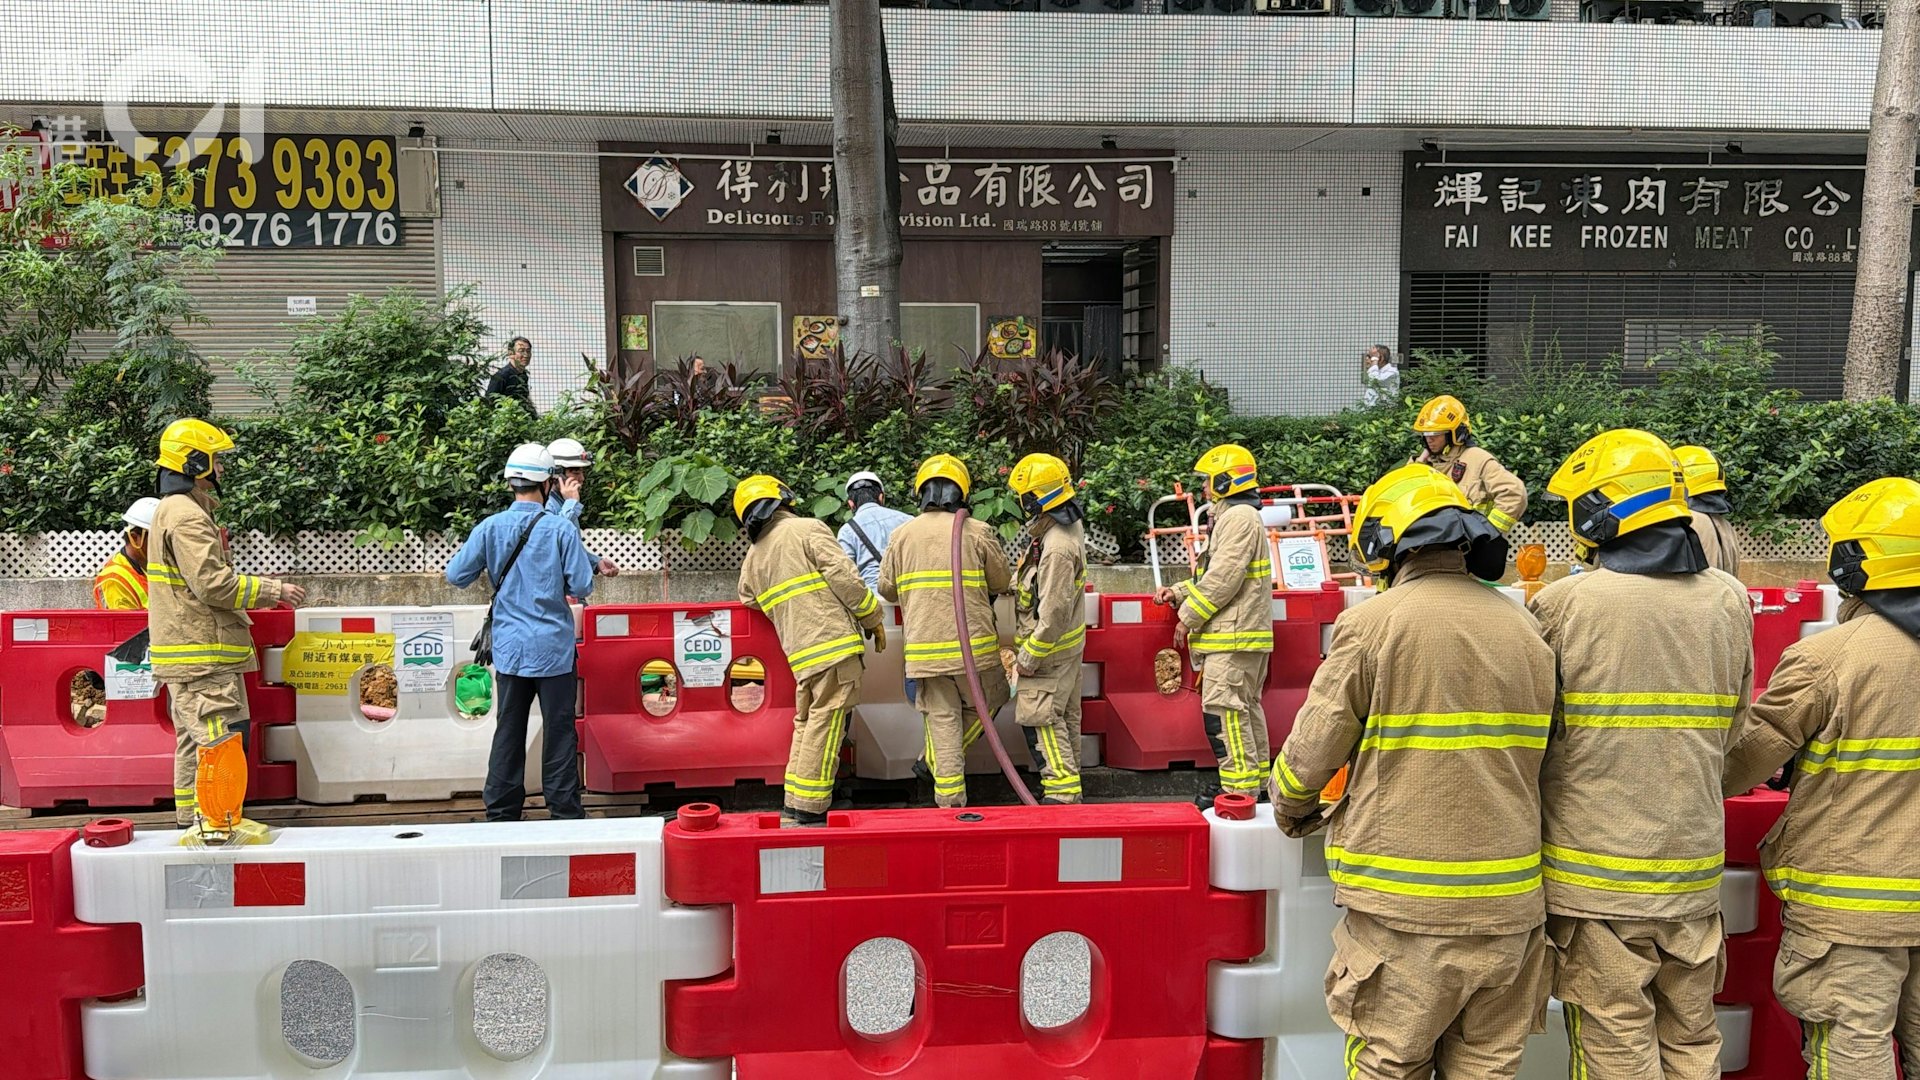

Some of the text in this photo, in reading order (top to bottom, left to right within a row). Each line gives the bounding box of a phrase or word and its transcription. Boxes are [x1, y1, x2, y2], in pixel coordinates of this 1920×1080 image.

[272, 137, 396, 210] 9383
[716, 159, 1154, 210] 得利品有限公司
[1434, 171, 1851, 218] 輝記凍肉有限公
[199, 212, 292, 246] 9276
[306, 211, 397, 246] 1776
[706, 208, 804, 226] Delicious
[959, 212, 997, 228] Ltd.
[1444, 225, 1478, 248] FAI
[1509, 225, 1552, 248] KEE
[1581, 225, 1669, 249] FROZEN
[1695, 226, 1752, 249] MEAT
[1288, 555, 1315, 566] CEDD
[403, 642, 444, 657] CEDD
[684, 639, 722, 653] CEDD
[303, 651, 374, 664] 附近有煤氣管
